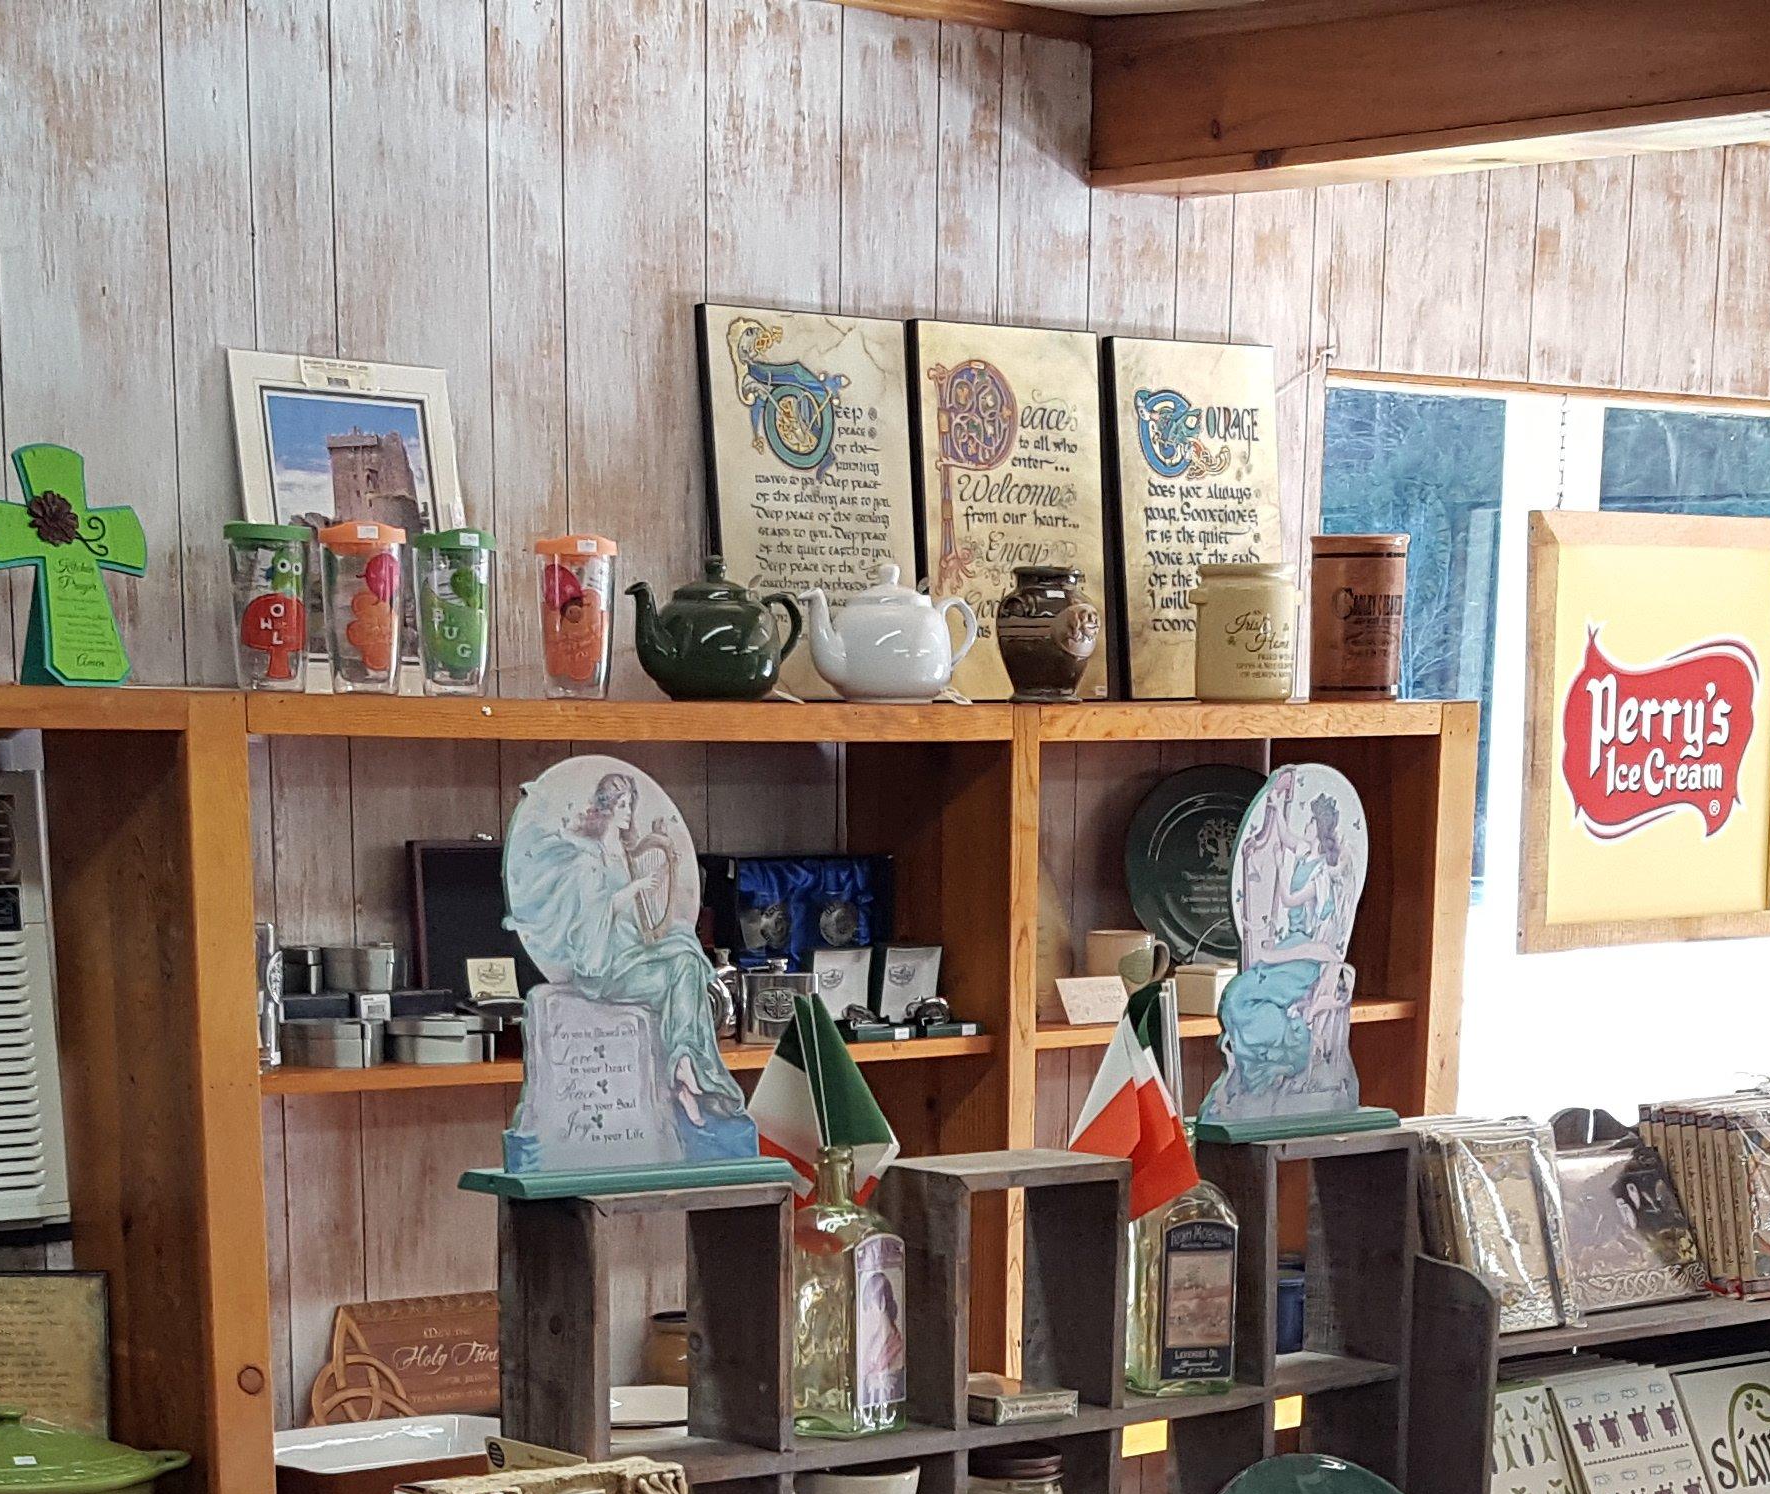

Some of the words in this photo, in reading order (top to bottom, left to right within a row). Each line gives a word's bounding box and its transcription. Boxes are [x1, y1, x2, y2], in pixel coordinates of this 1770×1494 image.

[1019, 436, 1030, 449] to
[1034, 436, 1049, 450] all
[1052, 439, 1078, 454] who
[957, 472, 1063, 508] Welcome
[963, 506, 998, 532] from
[1003, 511, 1028, 526] our
[985, 530, 1050, 566] Enjoy
[1584, 674, 1733, 778] Perry's
[392, 1343, 448, 1376] Holy
